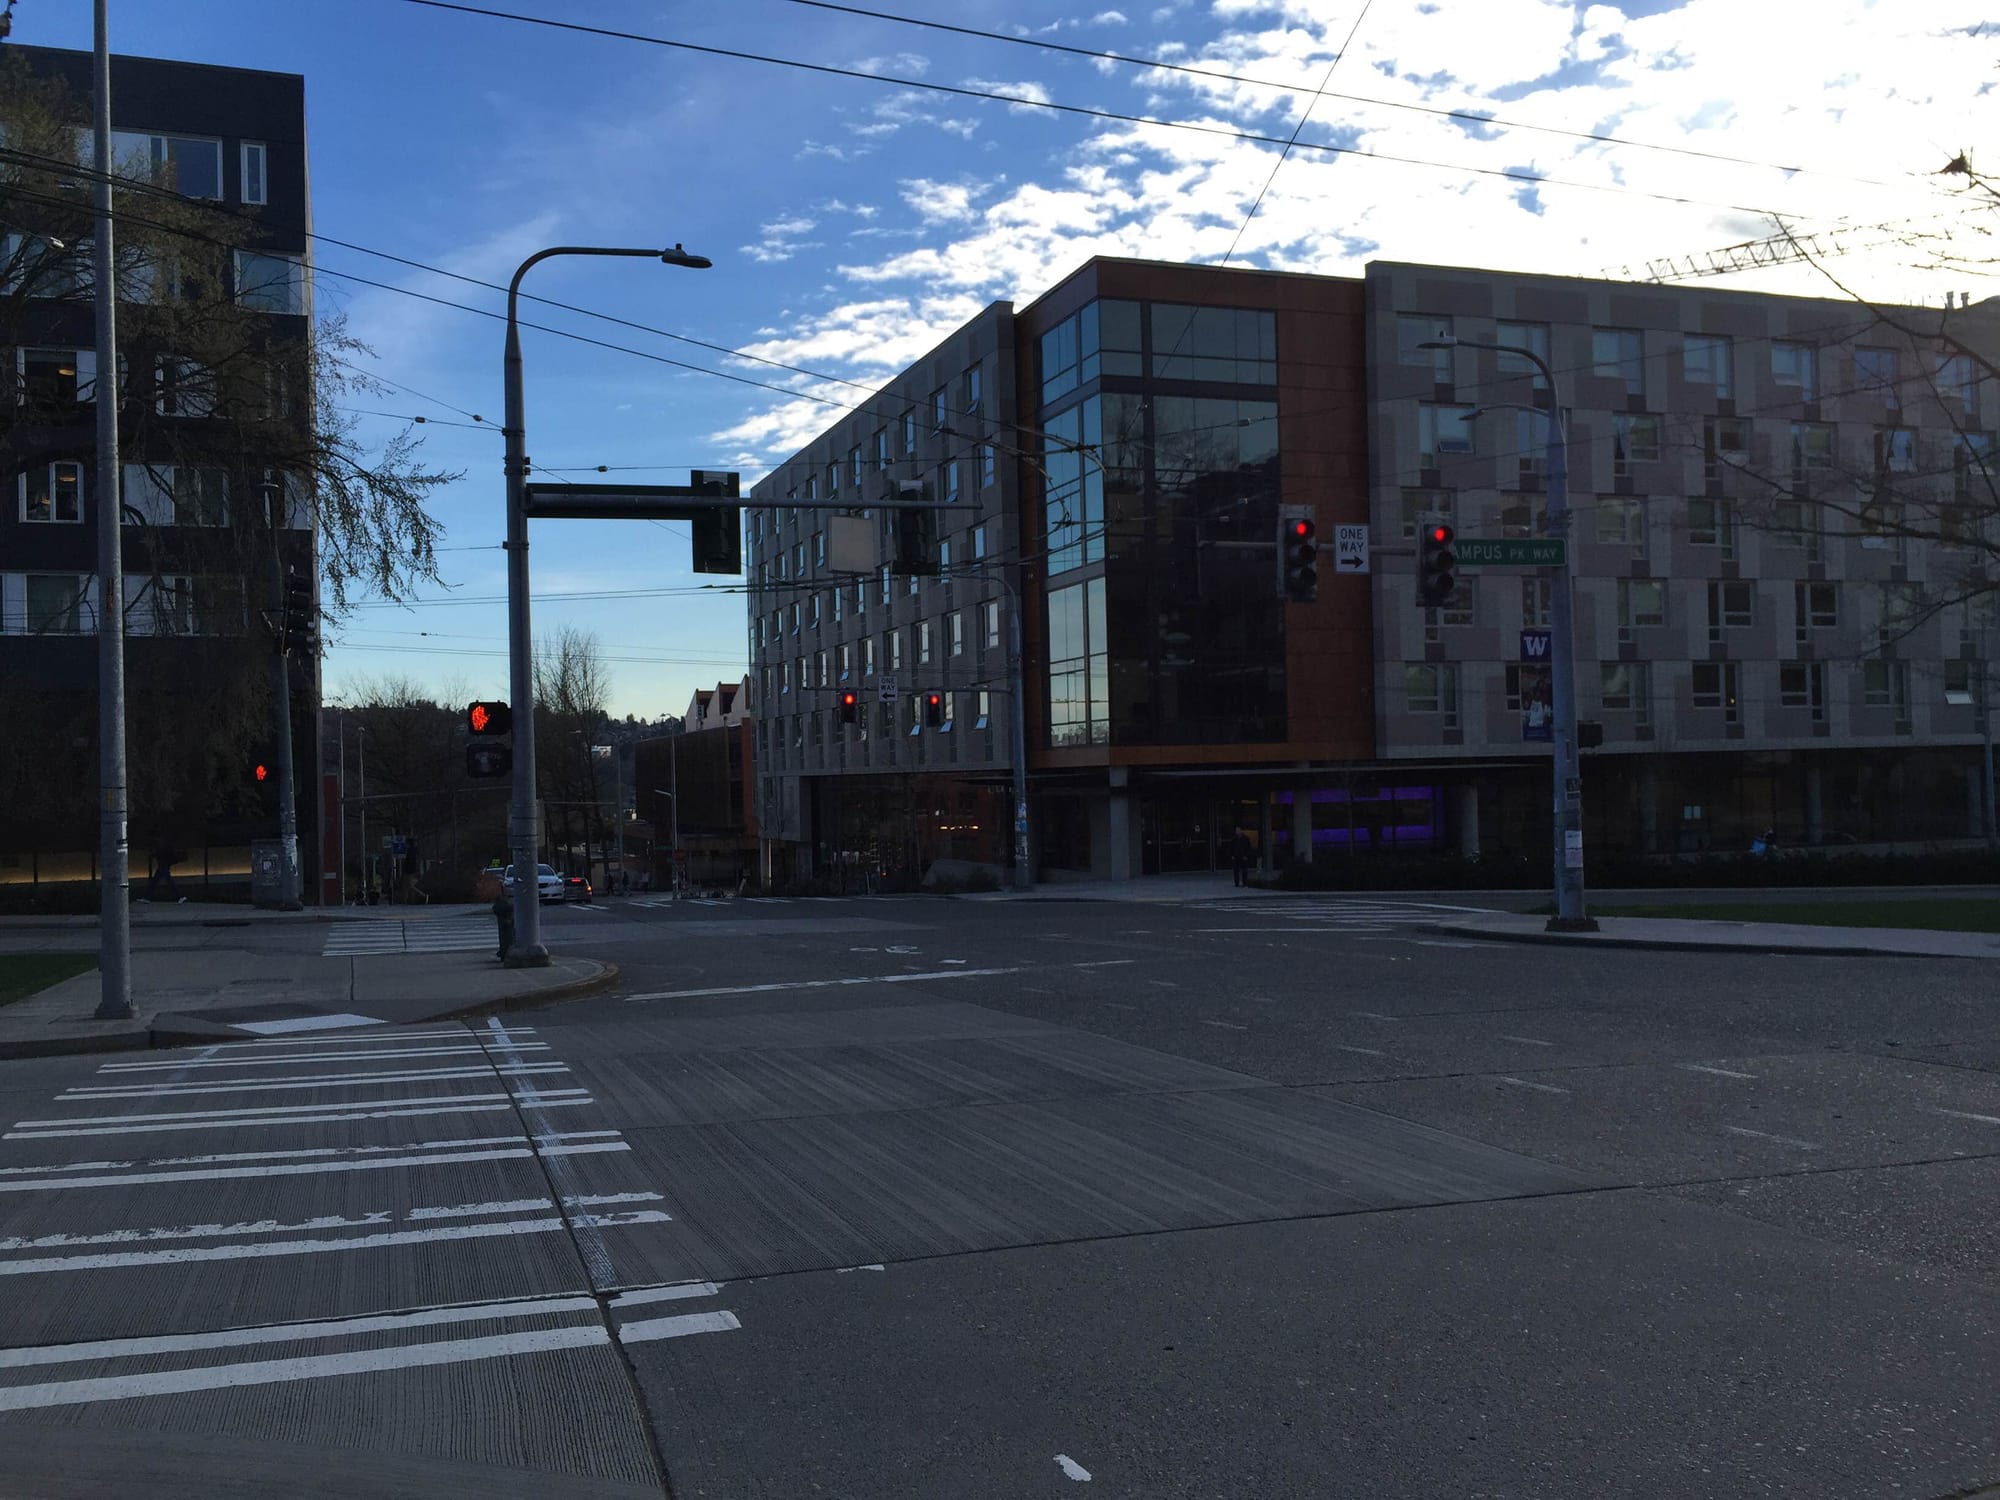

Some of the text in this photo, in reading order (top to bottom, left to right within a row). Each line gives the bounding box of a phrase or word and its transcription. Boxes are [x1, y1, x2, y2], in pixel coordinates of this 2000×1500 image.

[1340, 528, 1364, 540] ONE
[1340, 541, 1364, 553] WAY
[1454, 544, 1557, 560] AMPUS PK WAY
[1523, 636, 1548, 656] W
